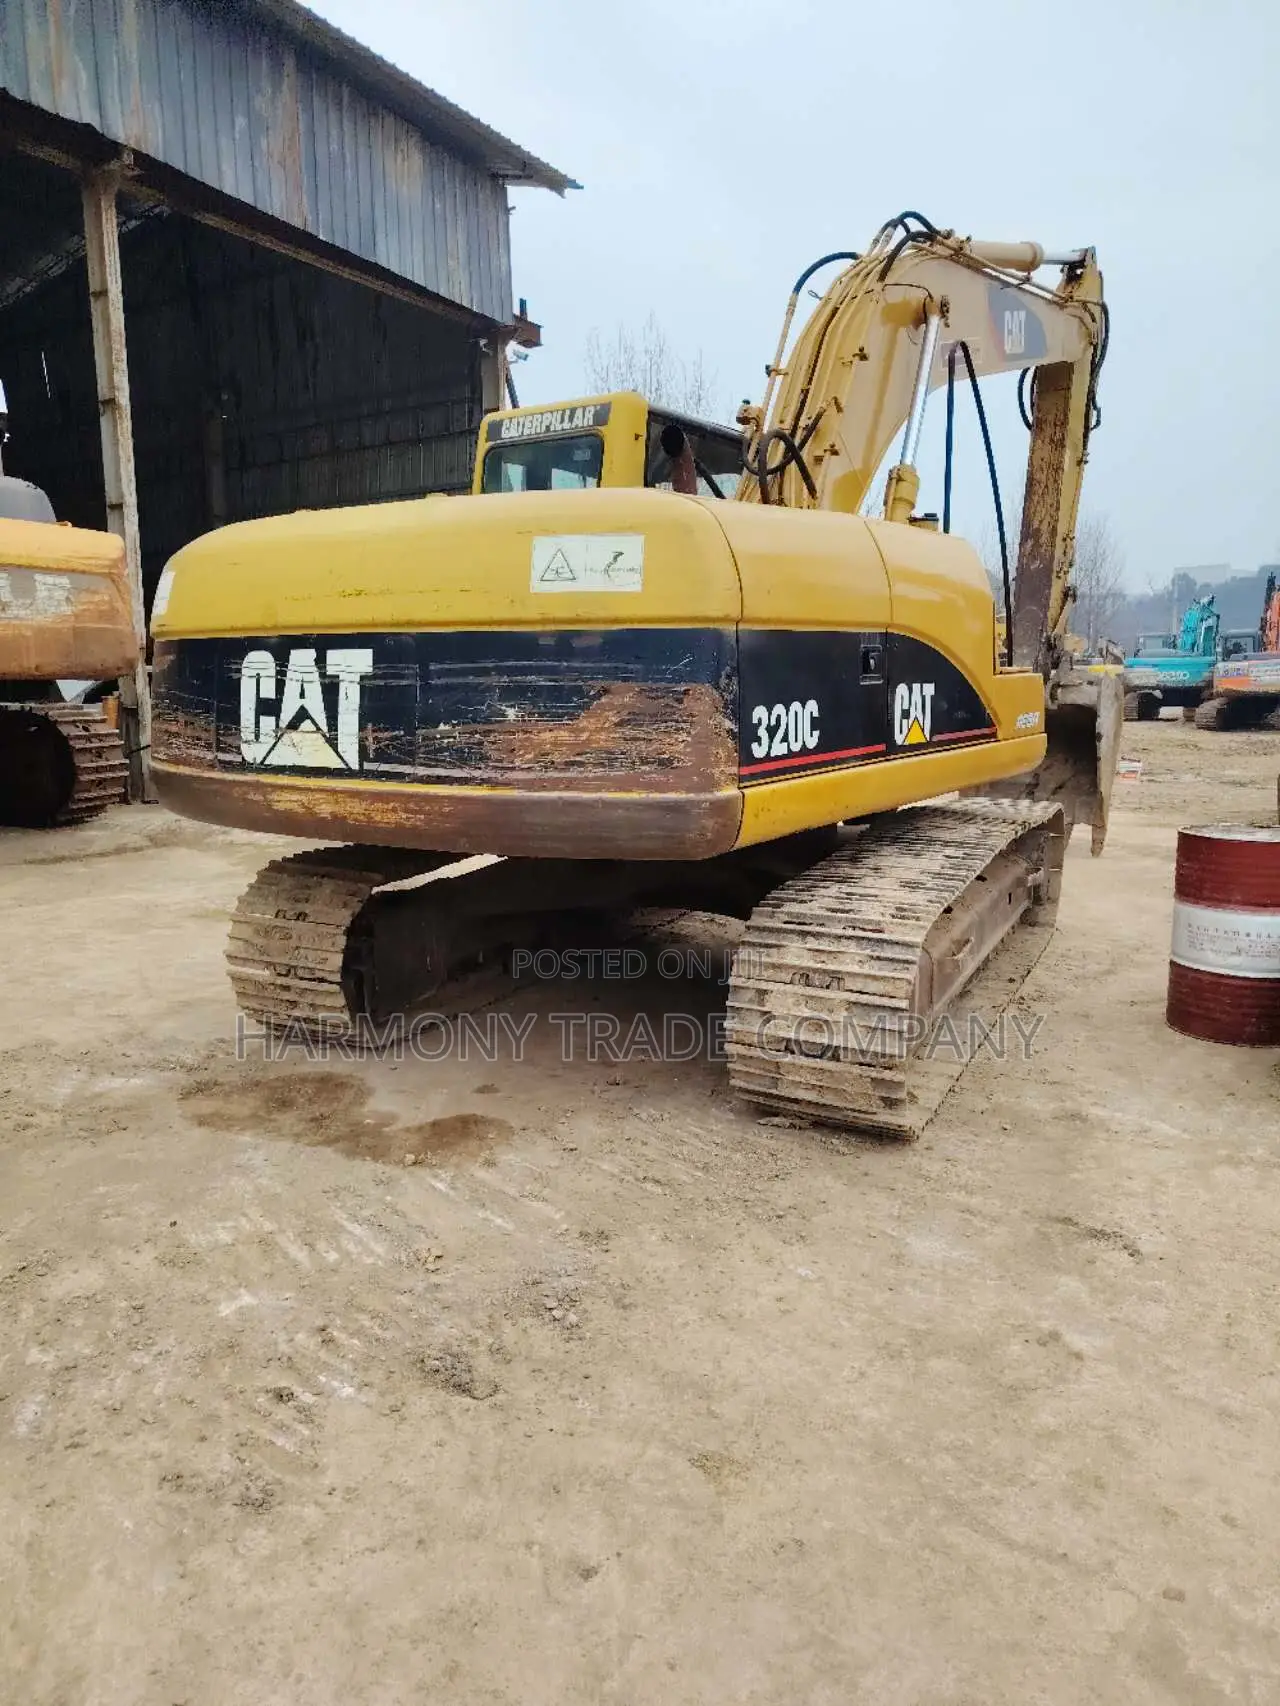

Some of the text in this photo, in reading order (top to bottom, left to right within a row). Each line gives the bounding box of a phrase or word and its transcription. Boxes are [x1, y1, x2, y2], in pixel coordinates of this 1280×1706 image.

[1004, 310, 1026, 354] CAT
[501, 405, 596, 438] CATERPILLAR
[240, 648, 374, 770] CAT
[751, 699, 820, 759] 320C
[894, 682, 935, 746] CAT
